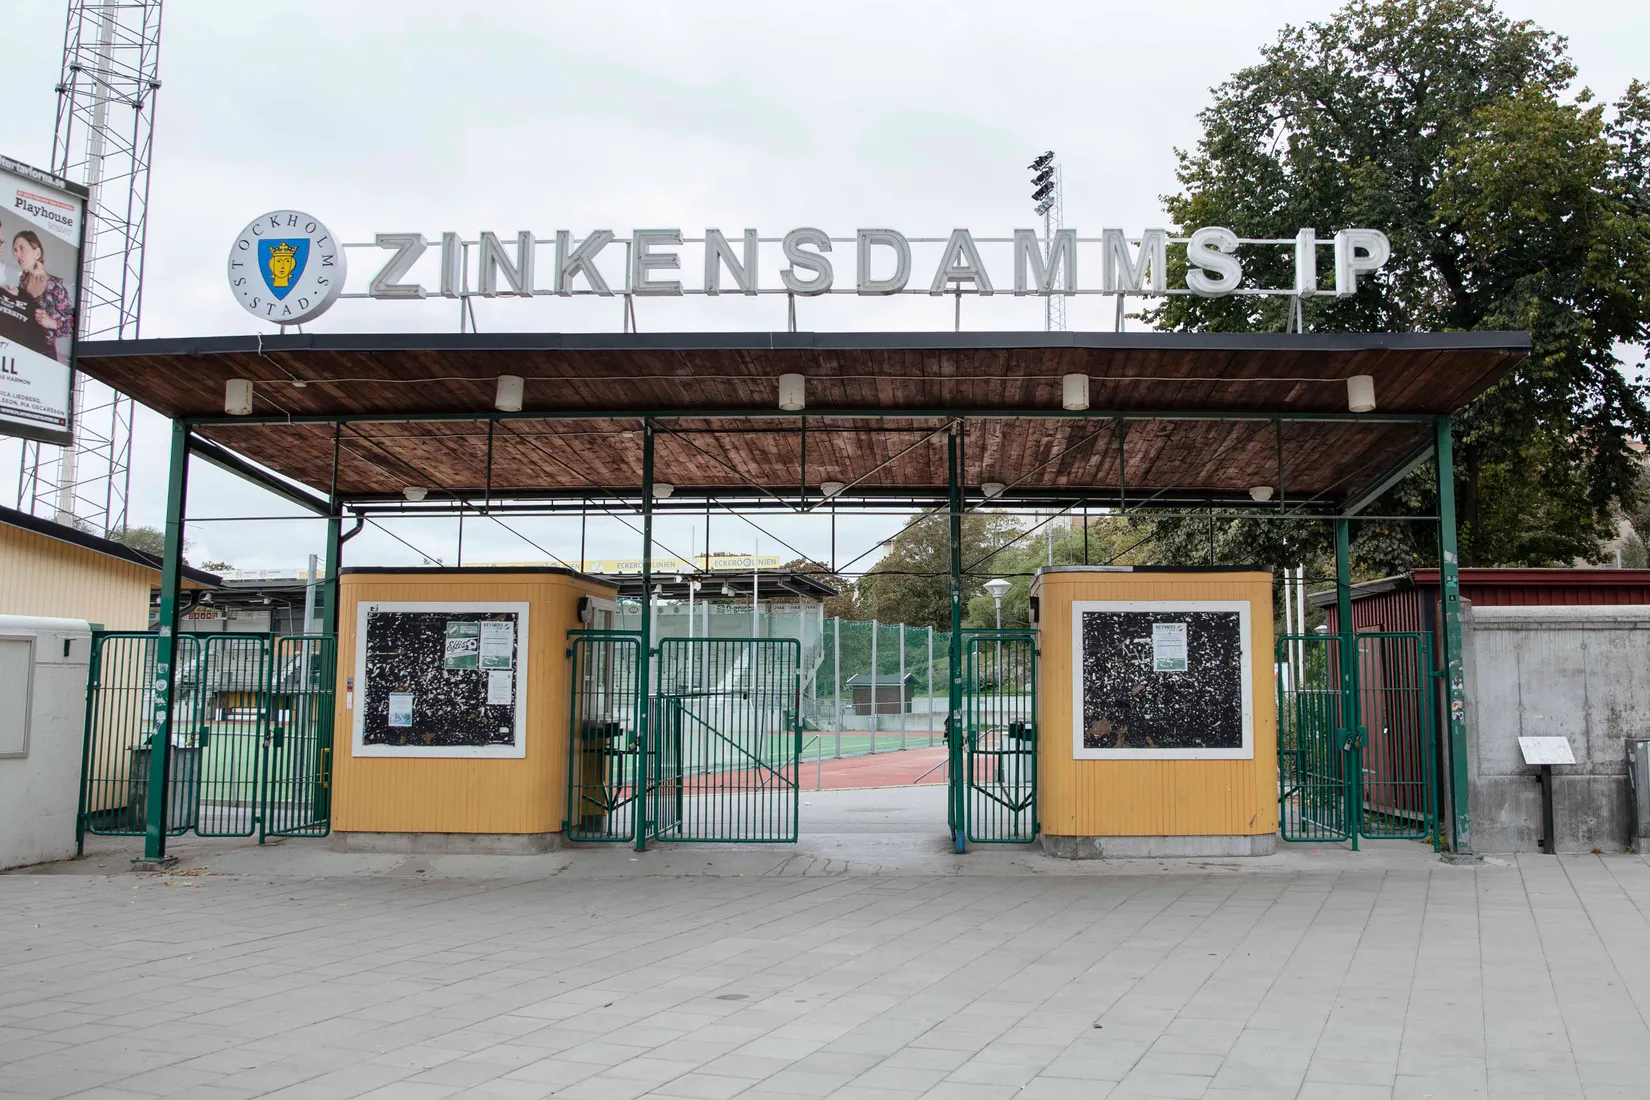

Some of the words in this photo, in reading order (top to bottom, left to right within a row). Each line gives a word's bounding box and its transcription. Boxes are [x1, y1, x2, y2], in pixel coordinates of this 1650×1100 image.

[15, 196, 73, 227] Playhouse
[232, 214, 334, 287] STOCKHOLMS
[368, 226, 1243, 299] ZINKENSDAMMS
[1296, 227, 1391, 298] IP
[249, 296, 310, 316] STAD
[714, 558, 741, 567] ECKERÖ
